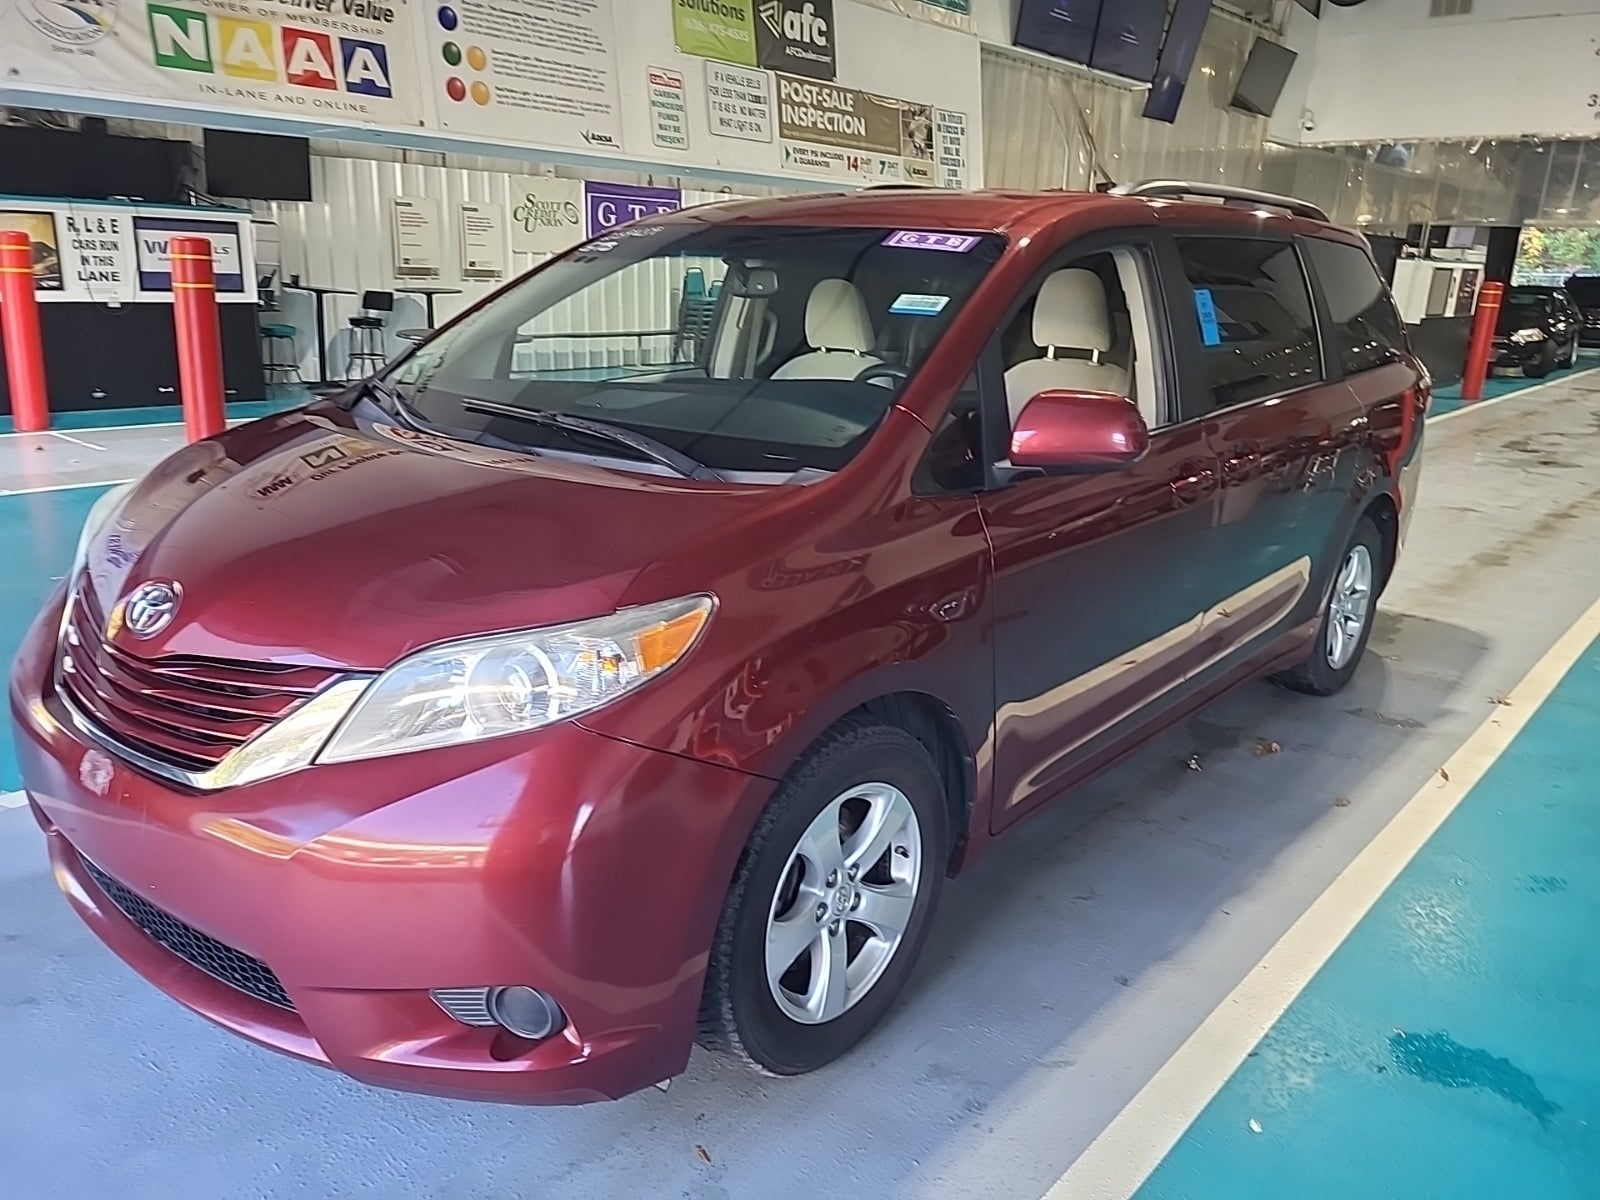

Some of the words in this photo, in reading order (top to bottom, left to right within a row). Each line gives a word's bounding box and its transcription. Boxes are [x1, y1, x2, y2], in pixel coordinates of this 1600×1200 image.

[343, 0, 394, 23] Value
[678, 0, 746, 21] solutions
[257, 7, 278, 18] OF
[285, 13, 384, 36] MEMBERSHIP
[783, 3, 829, 47] afc
[198, 83, 268, 101] IN-LANE
[273, 93, 306, 104] AND
[312, 99, 369, 113] ONLINE
[653, 89, 681, 101] CARBON
[780, 78, 855, 112] POST-SALE
[651, 100, 685, 113] MONOXIDE
[658, 112, 680, 122] FUMES
[748, 107, 768, 120] MATTER
[781, 103, 867, 137] INSPECTION
[658, 123, 672, 132] MAY
[673, 125, 682, 134] BE
[656, 134, 685, 145] PRESENT
[792, 146, 809, 158] EVERY
[820, 150, 845, 162] INCLUDES
[799, 157, 831, 169] GUARANTEE
[846, 155, 860, 172] 14
[878, 160, 887, 175] 7
[860, 156, 872, 166] DAY
[97, 217, 107, 233] &
[110, 218, 120, 234] E
[72, 238, 97, 250] CARS
[99, 239, 119, 251] RUN
[80, 254, 91, 266] IN
[92, 255, 114, 267] THIS
[77, 270, 121, 282] LANE
